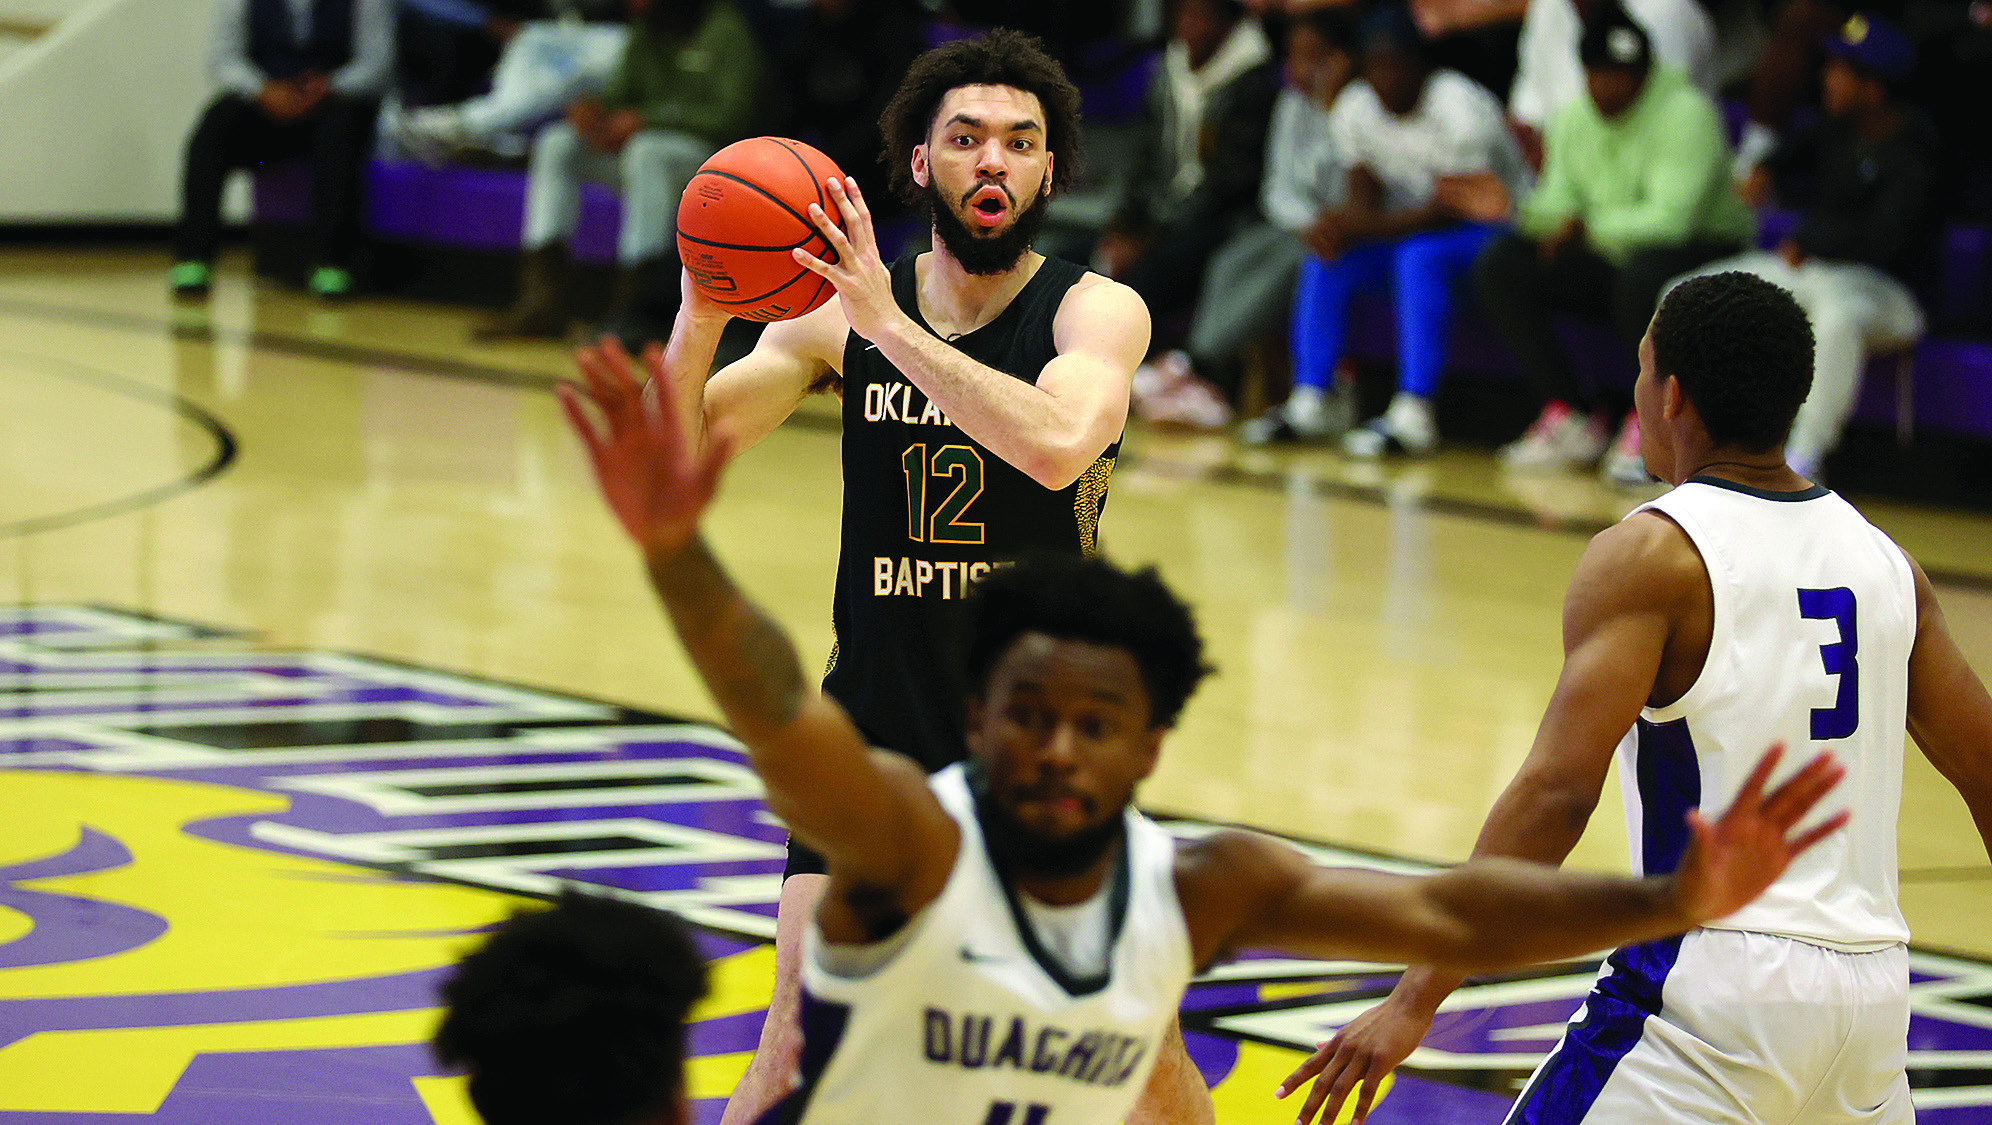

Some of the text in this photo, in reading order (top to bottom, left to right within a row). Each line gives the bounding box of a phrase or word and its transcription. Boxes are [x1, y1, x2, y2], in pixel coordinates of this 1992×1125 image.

[864, 381, 952, 426] OKLA
[901, 442, 985, 545] 12
[873, 556, 1016, 600] BAPTIS
[1796, 586, 1860, 741] 3
